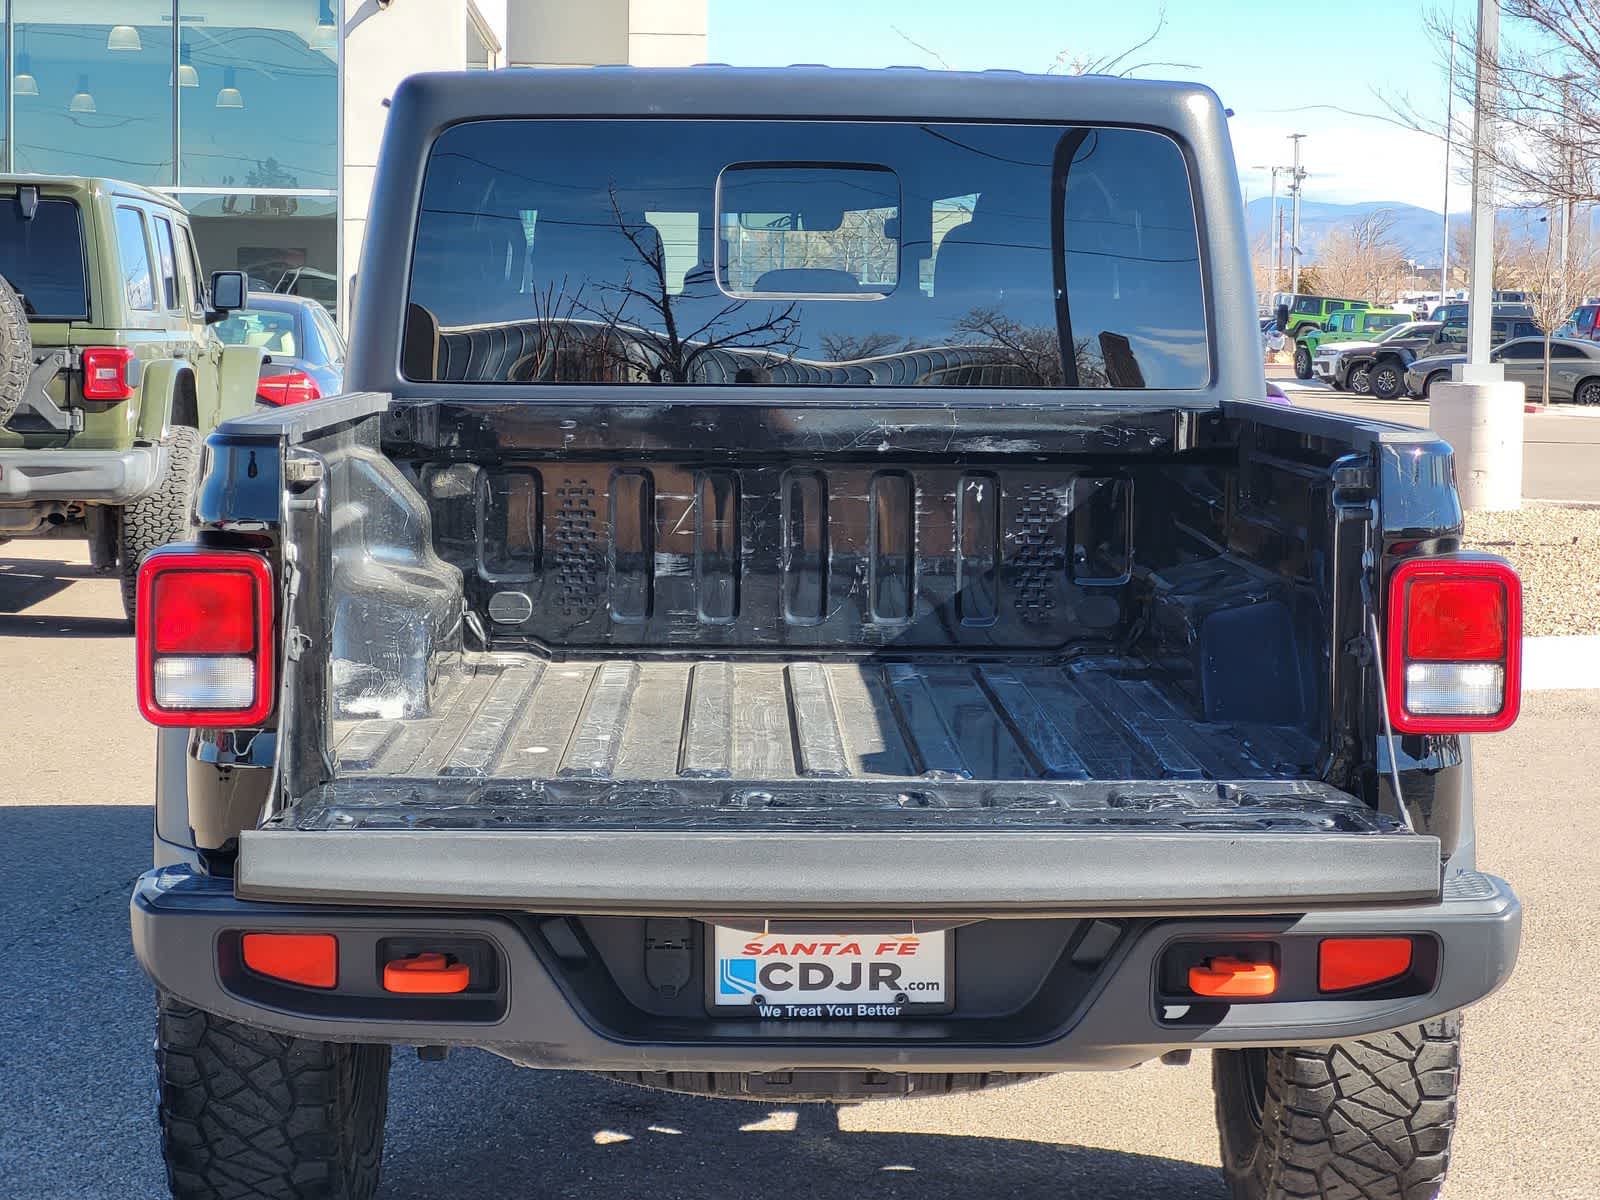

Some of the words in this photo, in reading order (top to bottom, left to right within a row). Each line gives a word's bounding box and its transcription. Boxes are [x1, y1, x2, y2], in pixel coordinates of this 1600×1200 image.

[742, 943, 863, 956] SANTA
[874, 943, 920, 956] FE
[759, 1005, 781, 1017] We
[786, 1005, 822, 1017] Treat
[826, 1005, 853, 1017] You
[858, 1004, 902, 1017] Better
